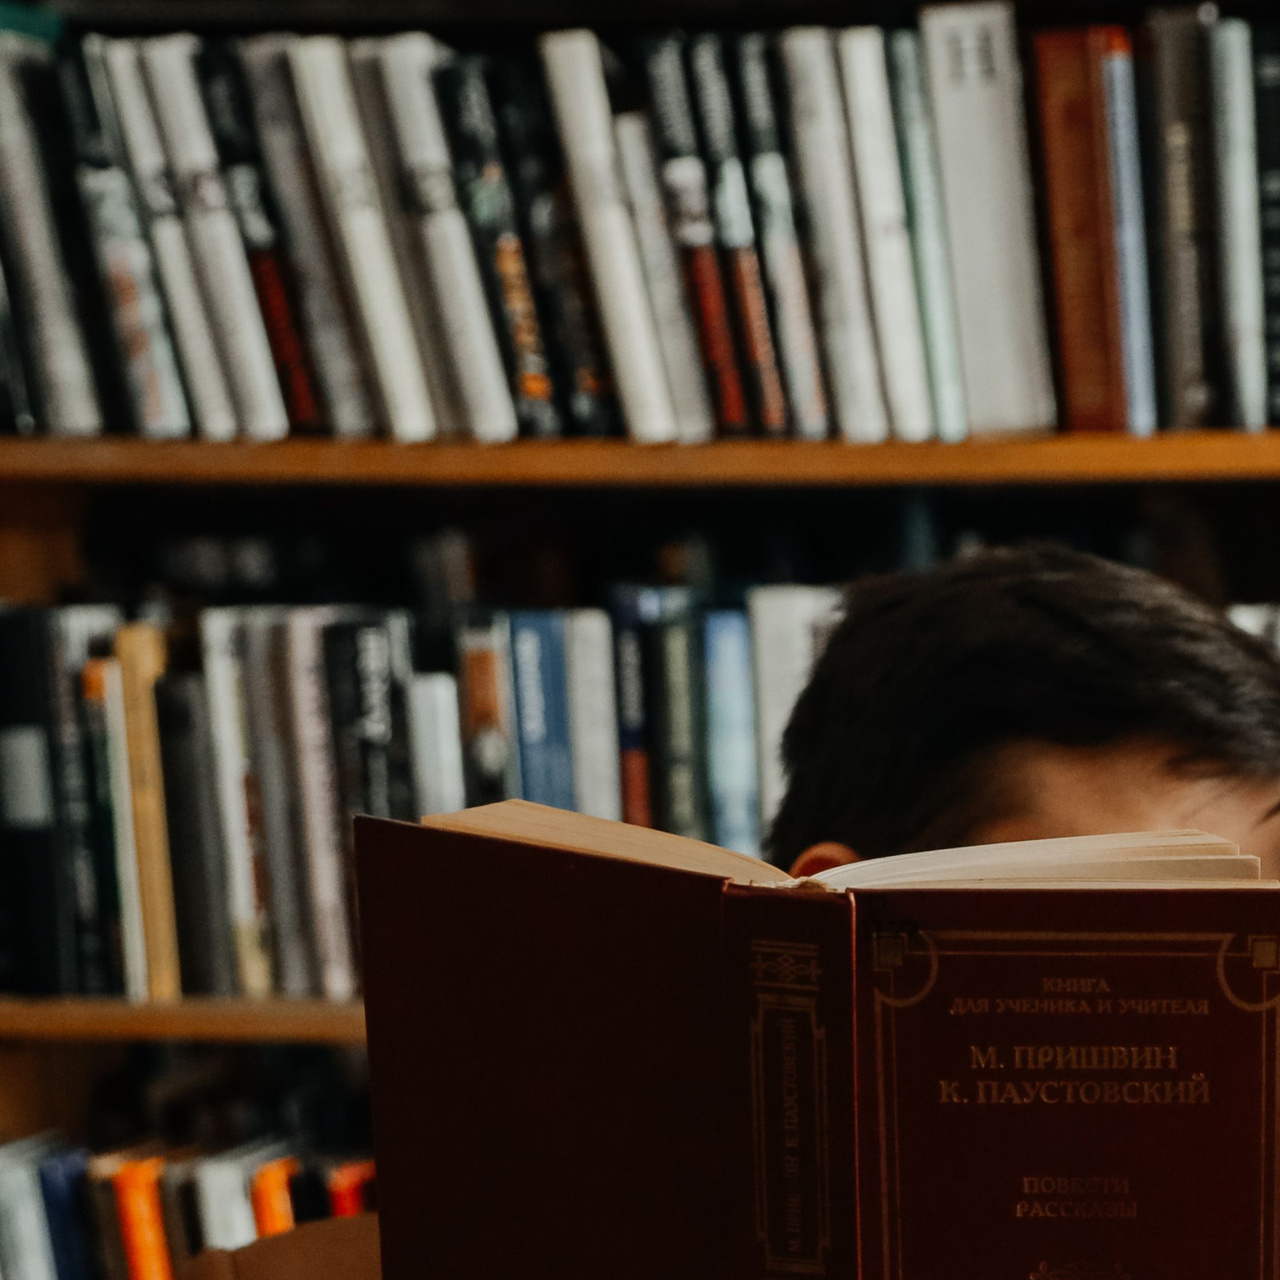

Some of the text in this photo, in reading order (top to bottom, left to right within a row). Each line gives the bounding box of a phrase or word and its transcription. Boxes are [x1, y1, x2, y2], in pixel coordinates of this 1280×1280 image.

[1042, 977, 1111, 993] КНИГА
[950, 998, 1210, 1015] ДЛЯ УЧЕНИКА И УЧИТЕЛЯ
[970, 1045, 1178, 1070] М. ПРИШВИН
[939, 1073, 1210, 1104] К. ПАУСТОВСКИЙ
[1022, 1176, 1130, 1194] ПОВЕСТИ
[1015, 1200, 1138, 1218] РАССКАЗЫ
